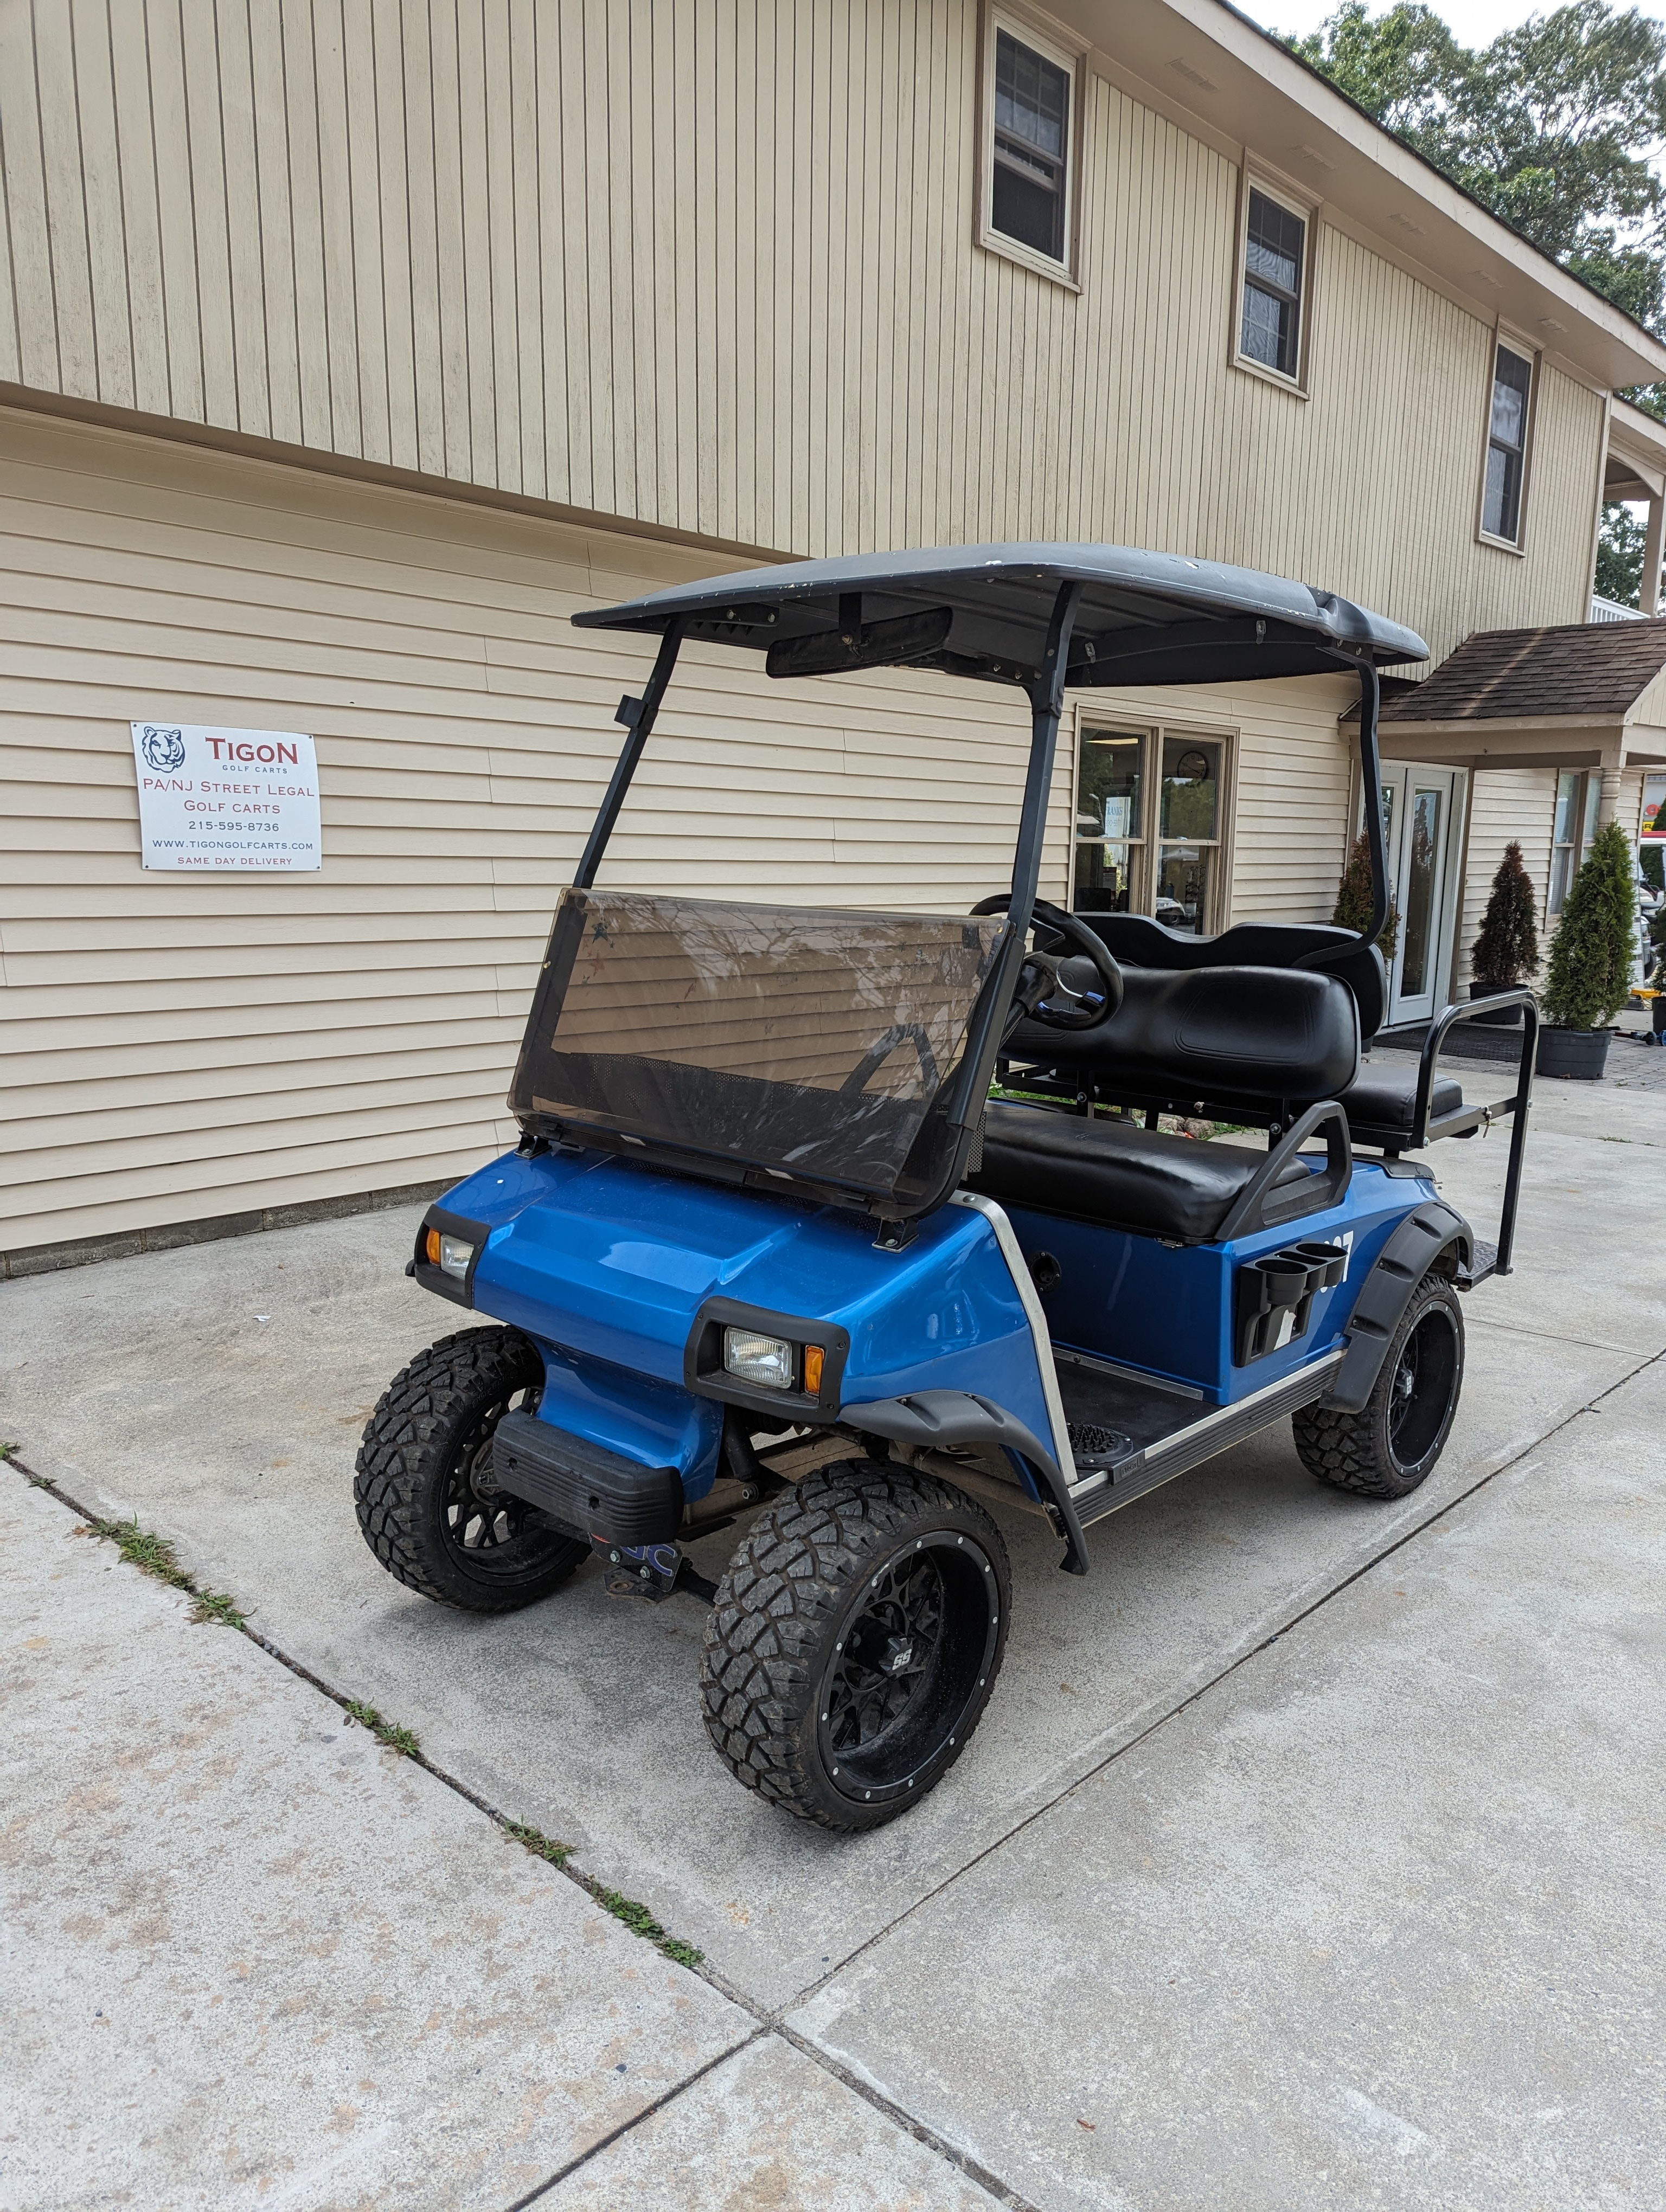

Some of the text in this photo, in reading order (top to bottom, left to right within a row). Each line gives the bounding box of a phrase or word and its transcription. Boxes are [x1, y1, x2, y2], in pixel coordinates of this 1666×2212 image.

[205, 736, 299, 764] TIGON
[143, 778, 315, 797] PA/NJ STREET LEGAL
[184, 800, 281, 814] GOLF CARTS
[188, 821, 280, 832] 215-595-8736
[152, 840, 313, 851] WWW.TIGONGOLFCARTS.COM
[177, 857, 210, 865] SAME
